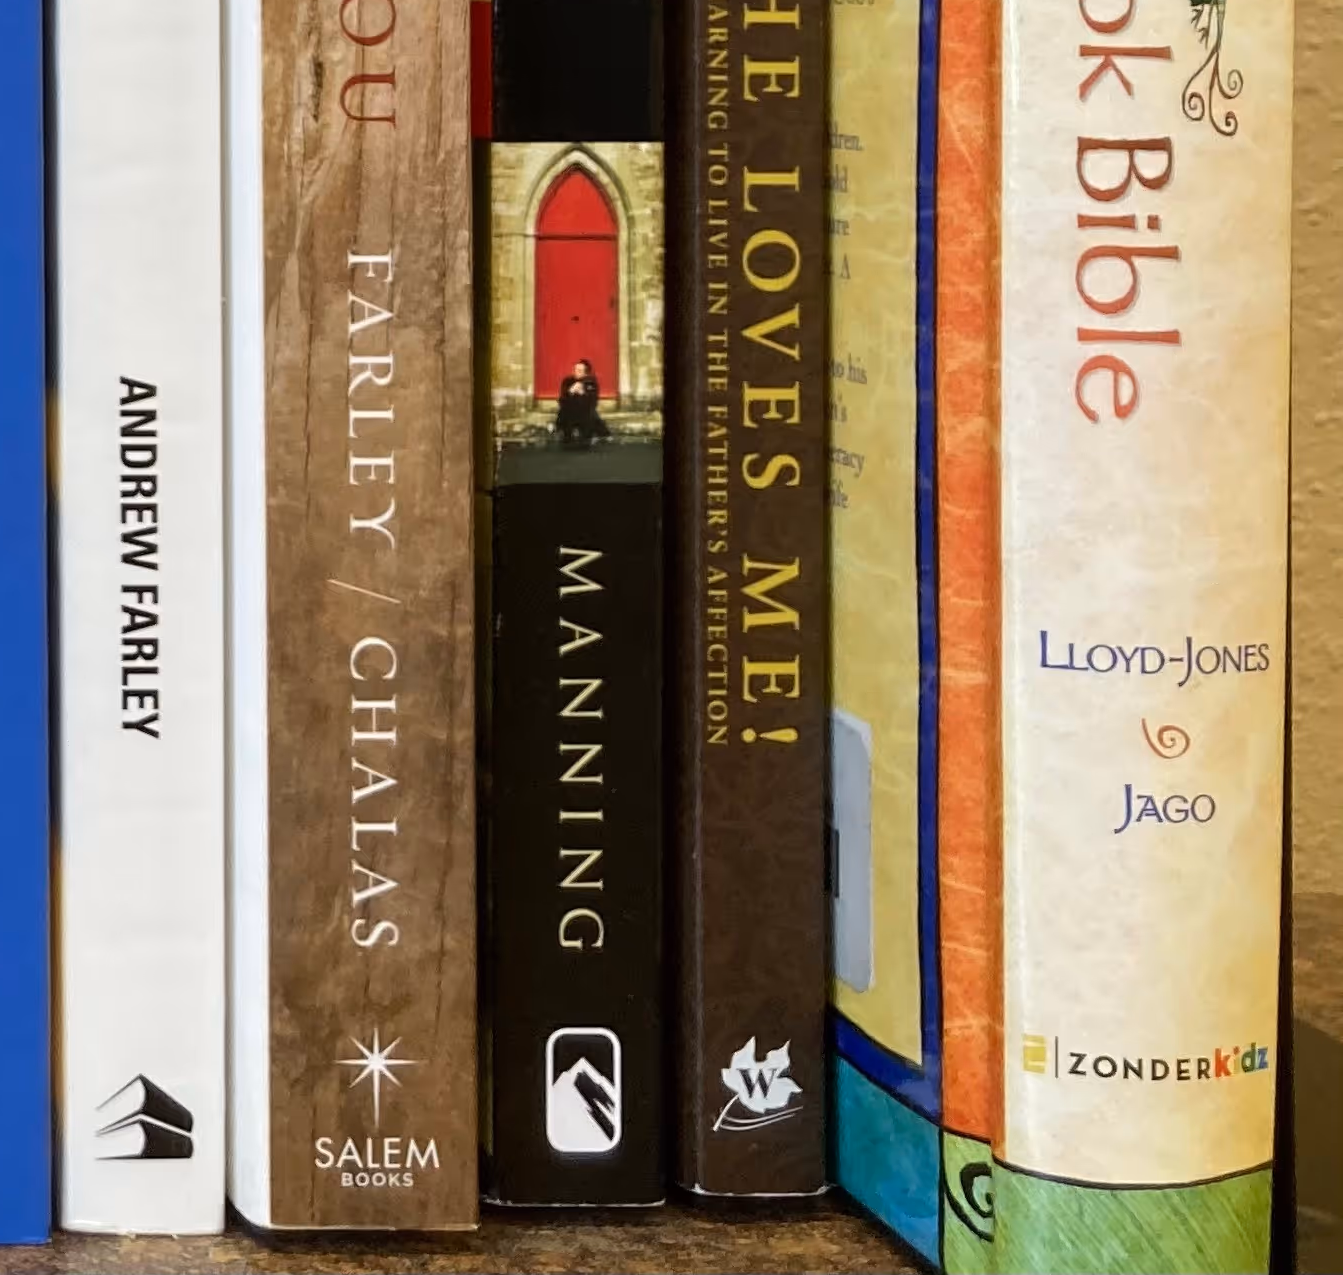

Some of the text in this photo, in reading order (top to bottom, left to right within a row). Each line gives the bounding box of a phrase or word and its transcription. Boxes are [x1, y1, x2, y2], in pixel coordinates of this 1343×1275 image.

[707, 141, 729, 183] TO
[707, 196, 729, 270] LIVE
[707, 283, 729, 317] IN
[707, 328, 729, 396] THE
[741, 166, 801, 492] LOVES
[1074, 135, 1182, 424] Bible
[346, 249, 396, 551] FARLEY
[707, 405, 729, 553] FATHER'S
[119, 376, 161, 740] ANDREW FARLEY
[707, 558, 729, 746] AFFECTION
[742, 555, 801, 744] ME!
[349, 635, 400, 948] CHALAS
[558, 545, 604, 953] MANNING
[1114, 784, 1215, 833] JAGO
[316, 1137, 440, 1169] SALEM
[341, 1171, 414, 1187] BOOKS
